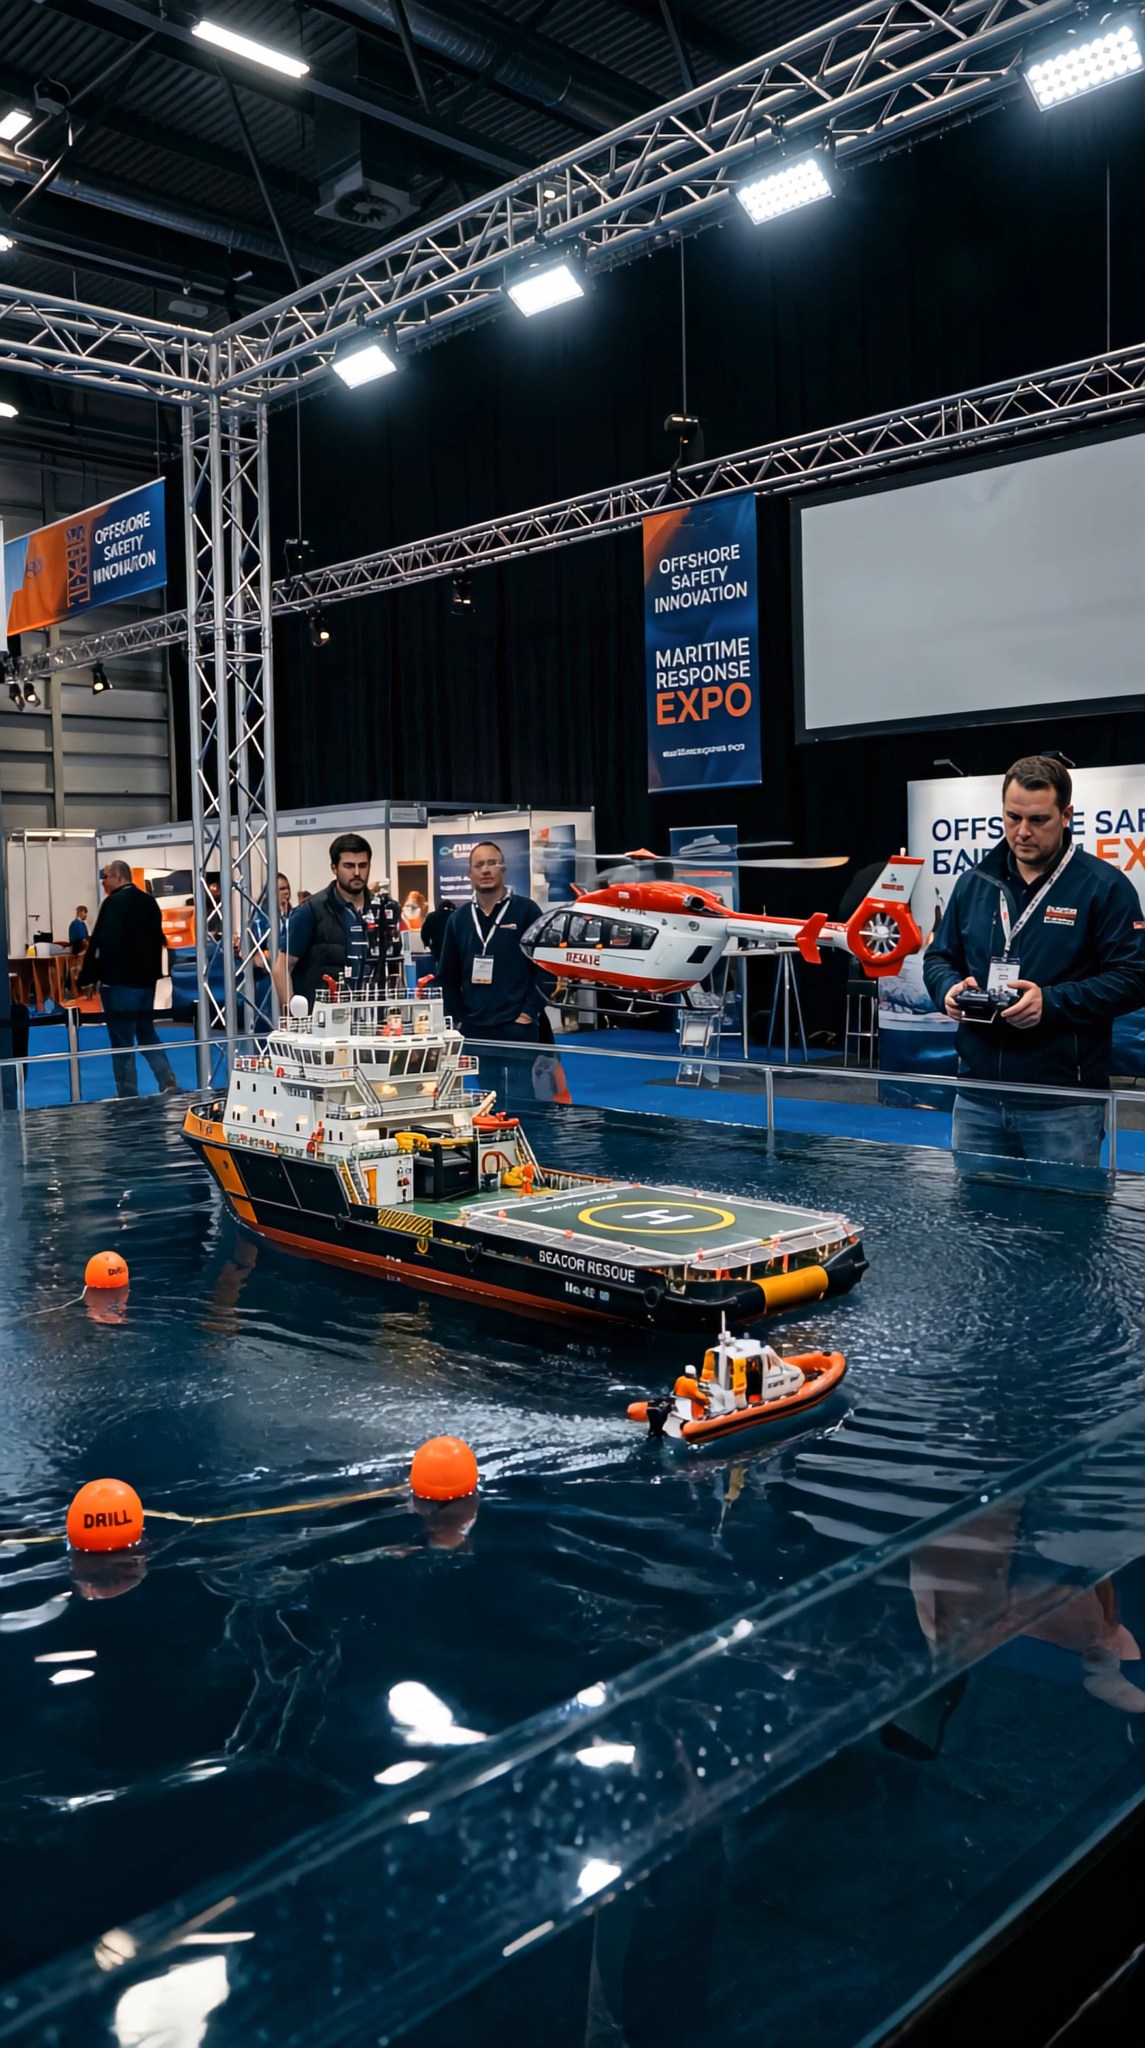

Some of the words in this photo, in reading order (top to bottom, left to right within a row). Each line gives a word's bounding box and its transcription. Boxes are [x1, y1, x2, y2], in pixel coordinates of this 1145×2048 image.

[659, 544, 740, 574] OFFSHORE
[671, 565, 728, 591] SAFETY
[655, 580, 748, 613] INNOVATION
[656, 637, 750, 669] MARITIME
[656, 659, 751, 690] RESPONSE
[656, 682, 752, 725] EXPO
[932, 811, 1085, 842] OFFSE
[83, 1509, 133, 1529] DRILL
